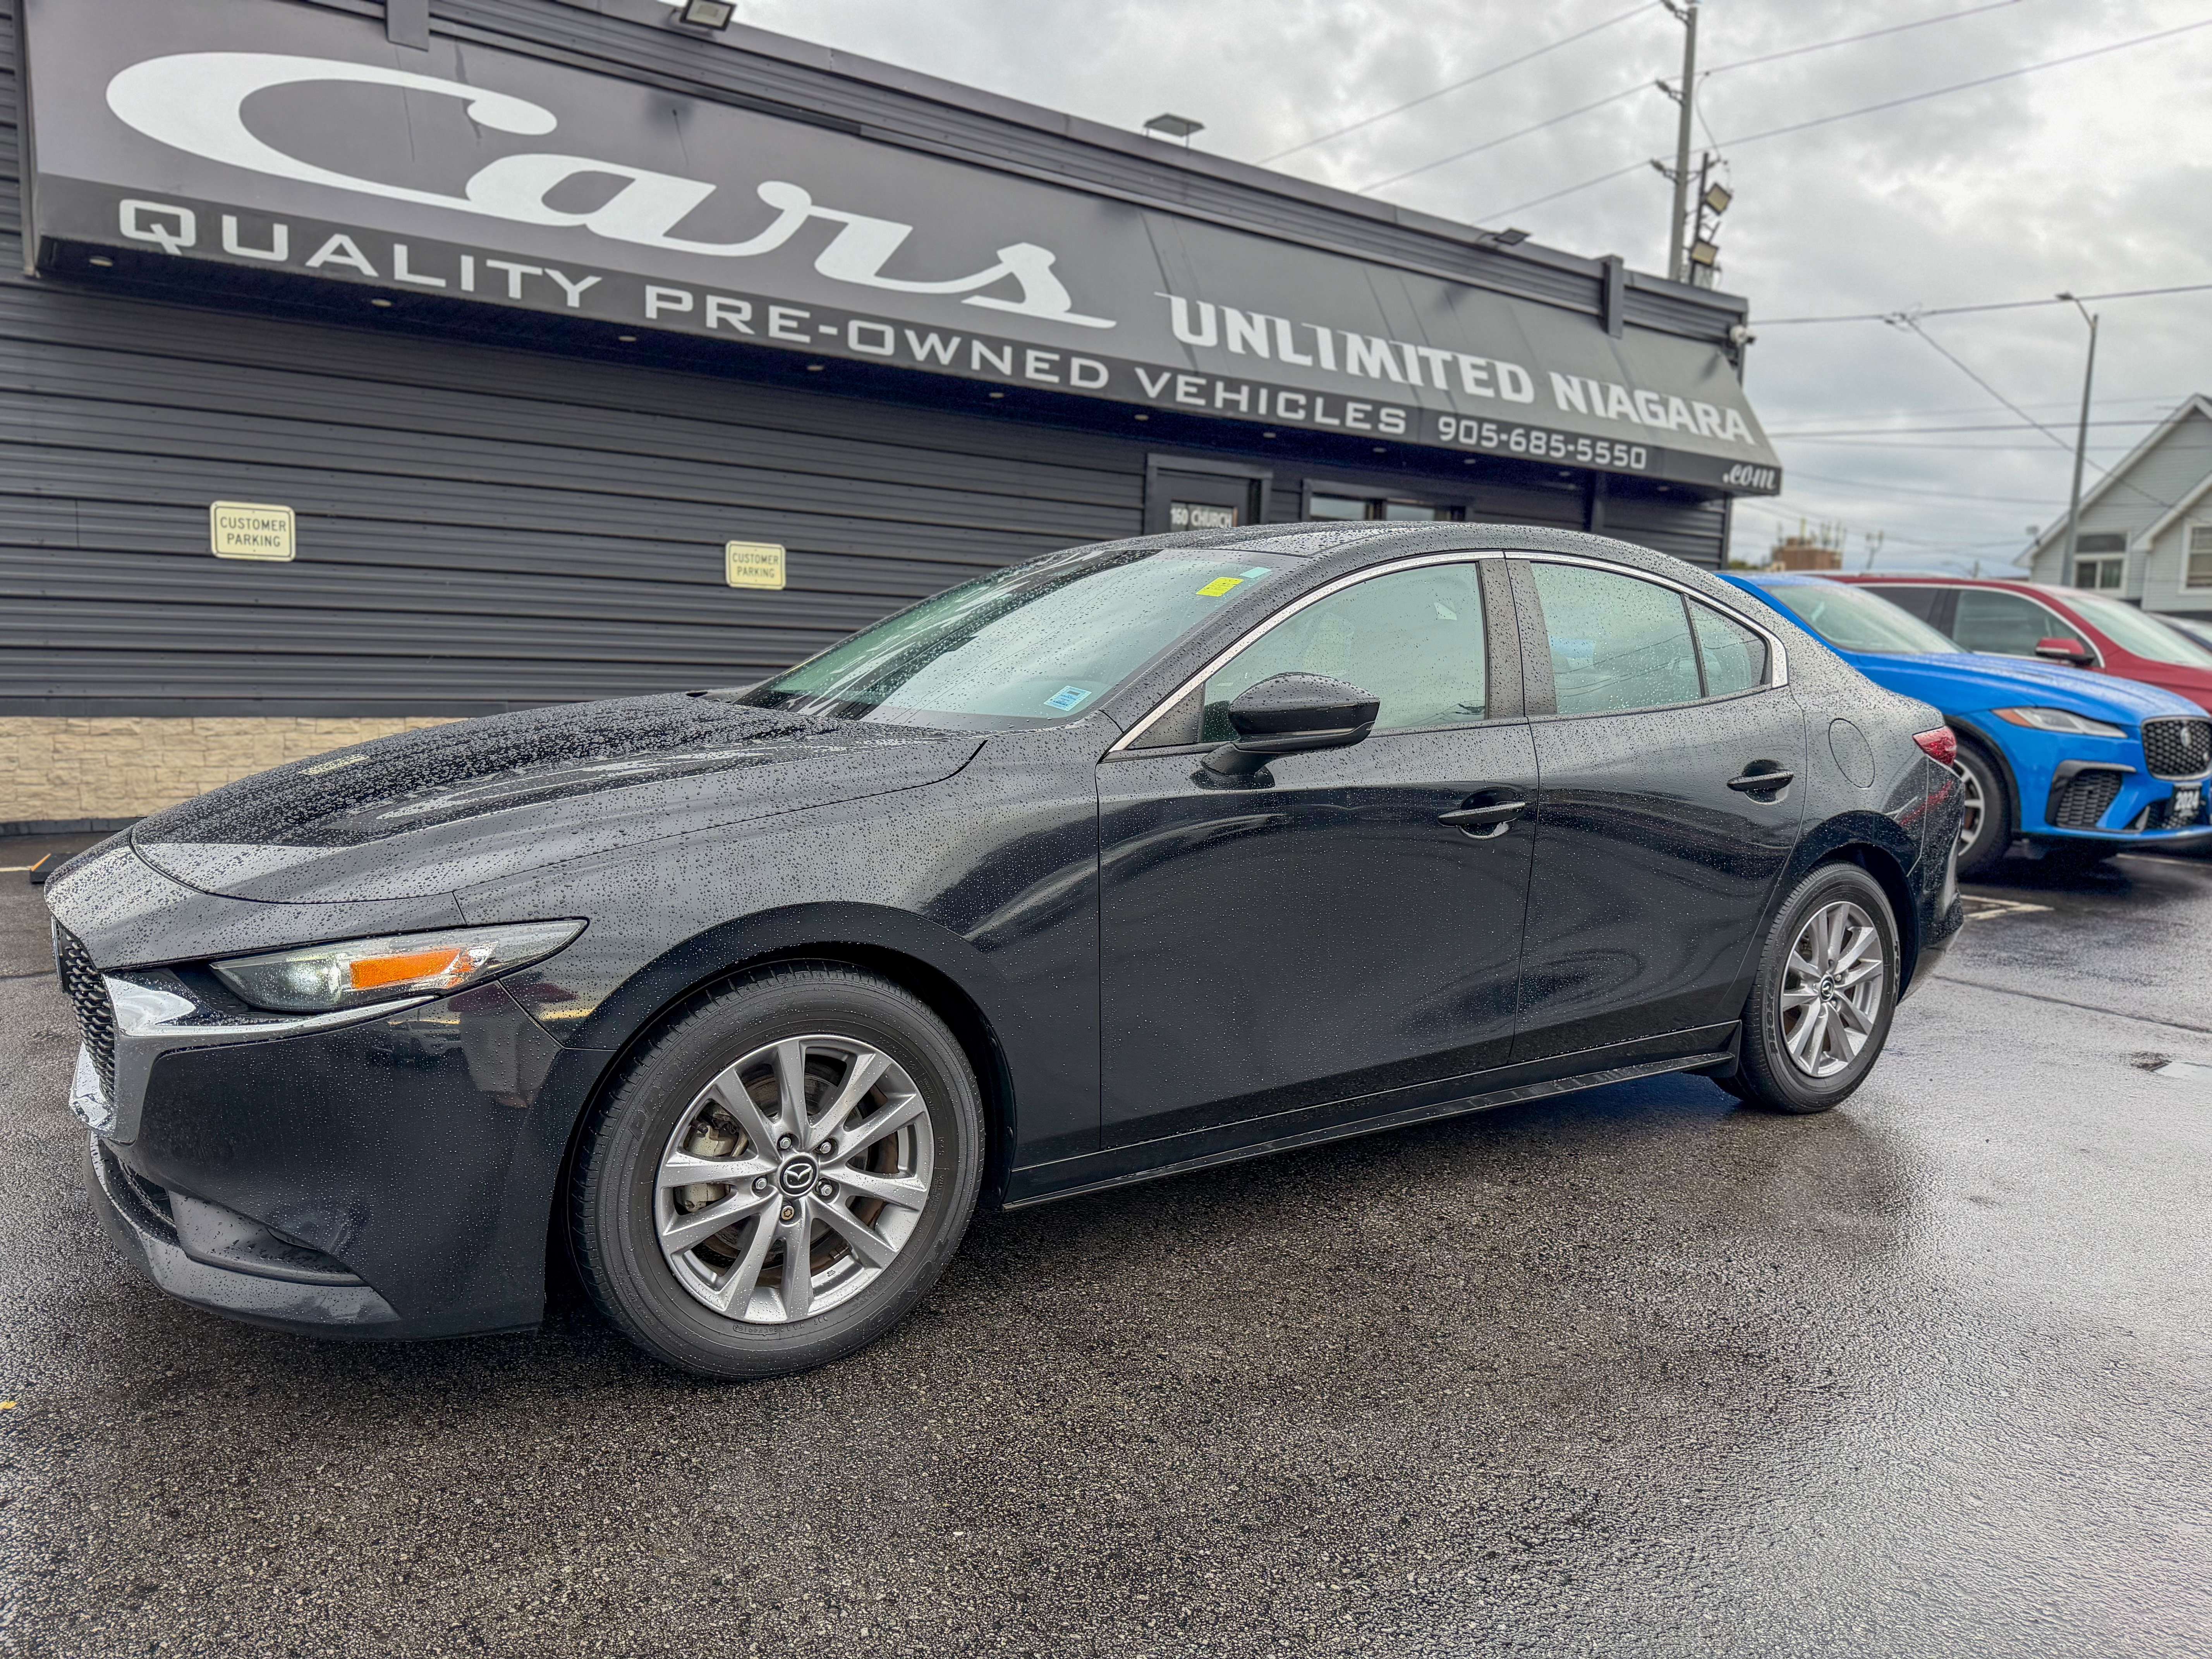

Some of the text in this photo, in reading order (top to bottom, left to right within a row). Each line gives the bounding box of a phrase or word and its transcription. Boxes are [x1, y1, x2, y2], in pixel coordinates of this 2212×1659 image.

[106, 52, 1116, 328] Cars
[120, 199, 1406, 434] QUALITY PRE-OWNED VEHICLES
[1153, 291, 1758, 446] UNLIMITED NIAGARA
[1438, 416, 1646, 469] 905-685-5550
[1723, 464, 1777, 489] .com
[220, 516, 287, 532] CUSTOMER
[1170, 508, 1233, 528] 160 CHURCH
[227, 533, 281, 547] PARKING
[732, 553, 779, 565] CUSTOMER
[737, 566, 775, 578] PARKING
[2174, 791, 2200, 811] 2024
